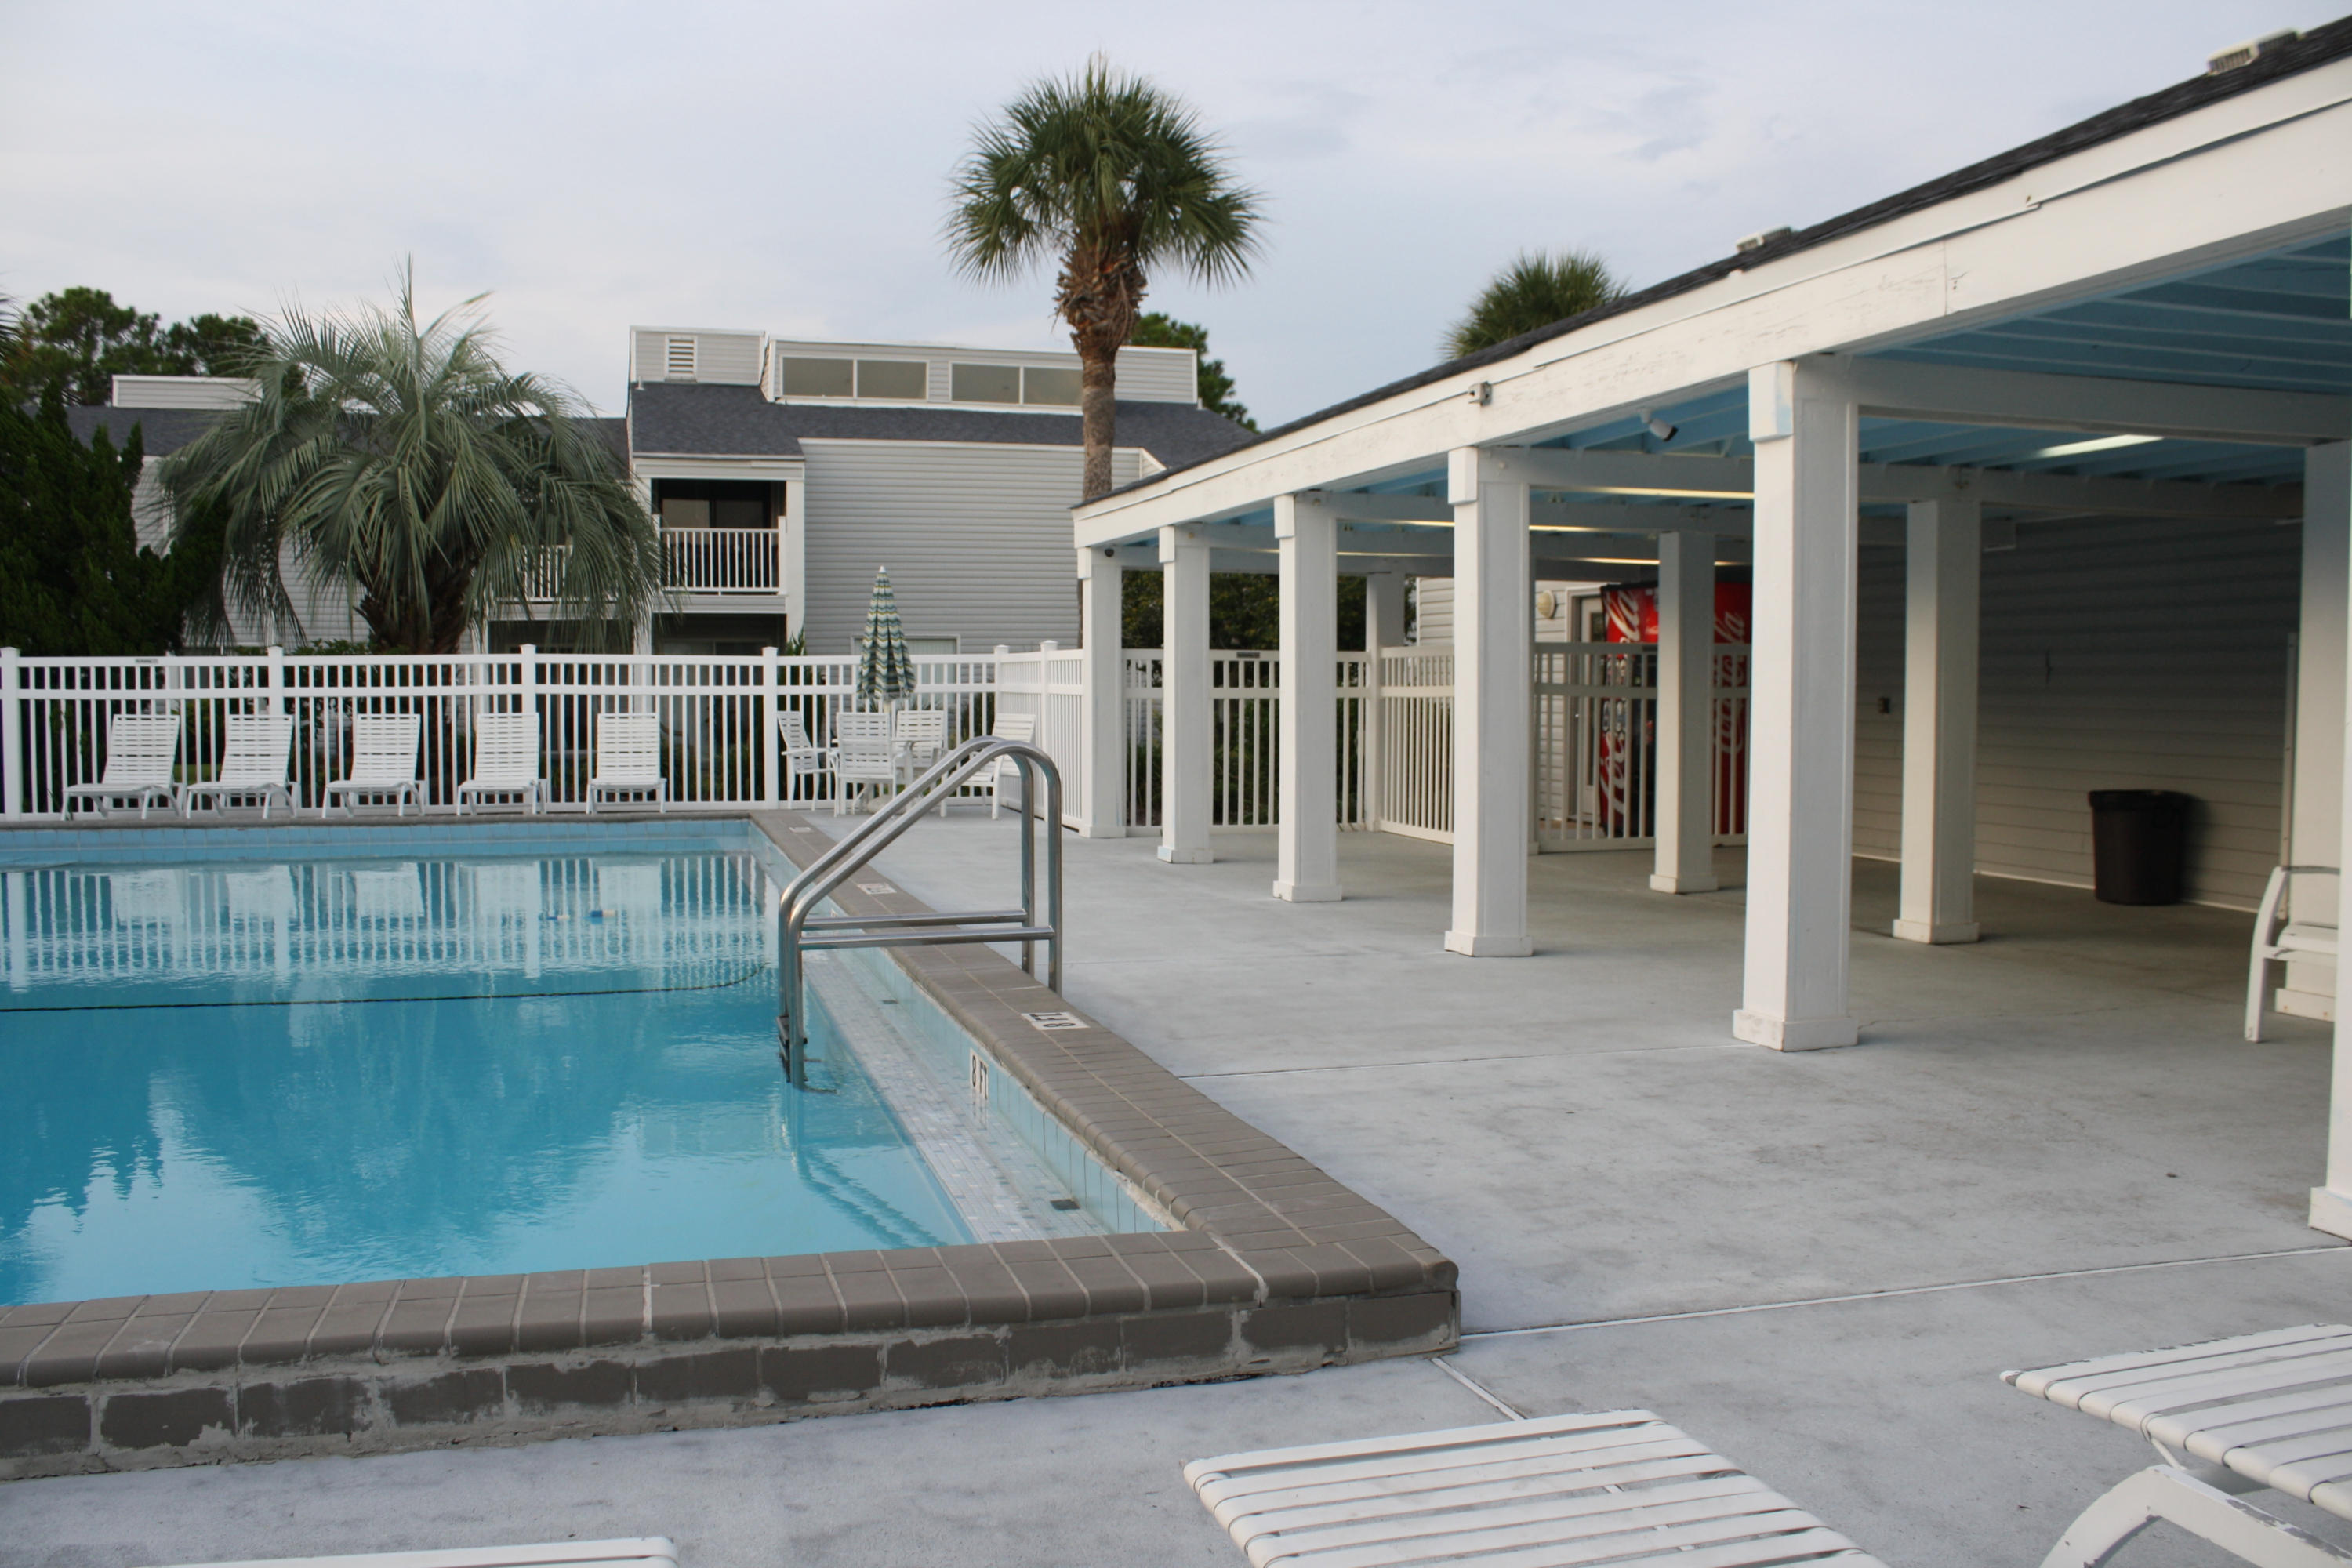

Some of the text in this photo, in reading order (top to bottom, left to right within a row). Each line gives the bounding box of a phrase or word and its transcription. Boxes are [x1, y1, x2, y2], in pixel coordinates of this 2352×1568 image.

[1029, 1012, 1069, 1021] FT
[972, 1054, 988, 1100] 8 FT
